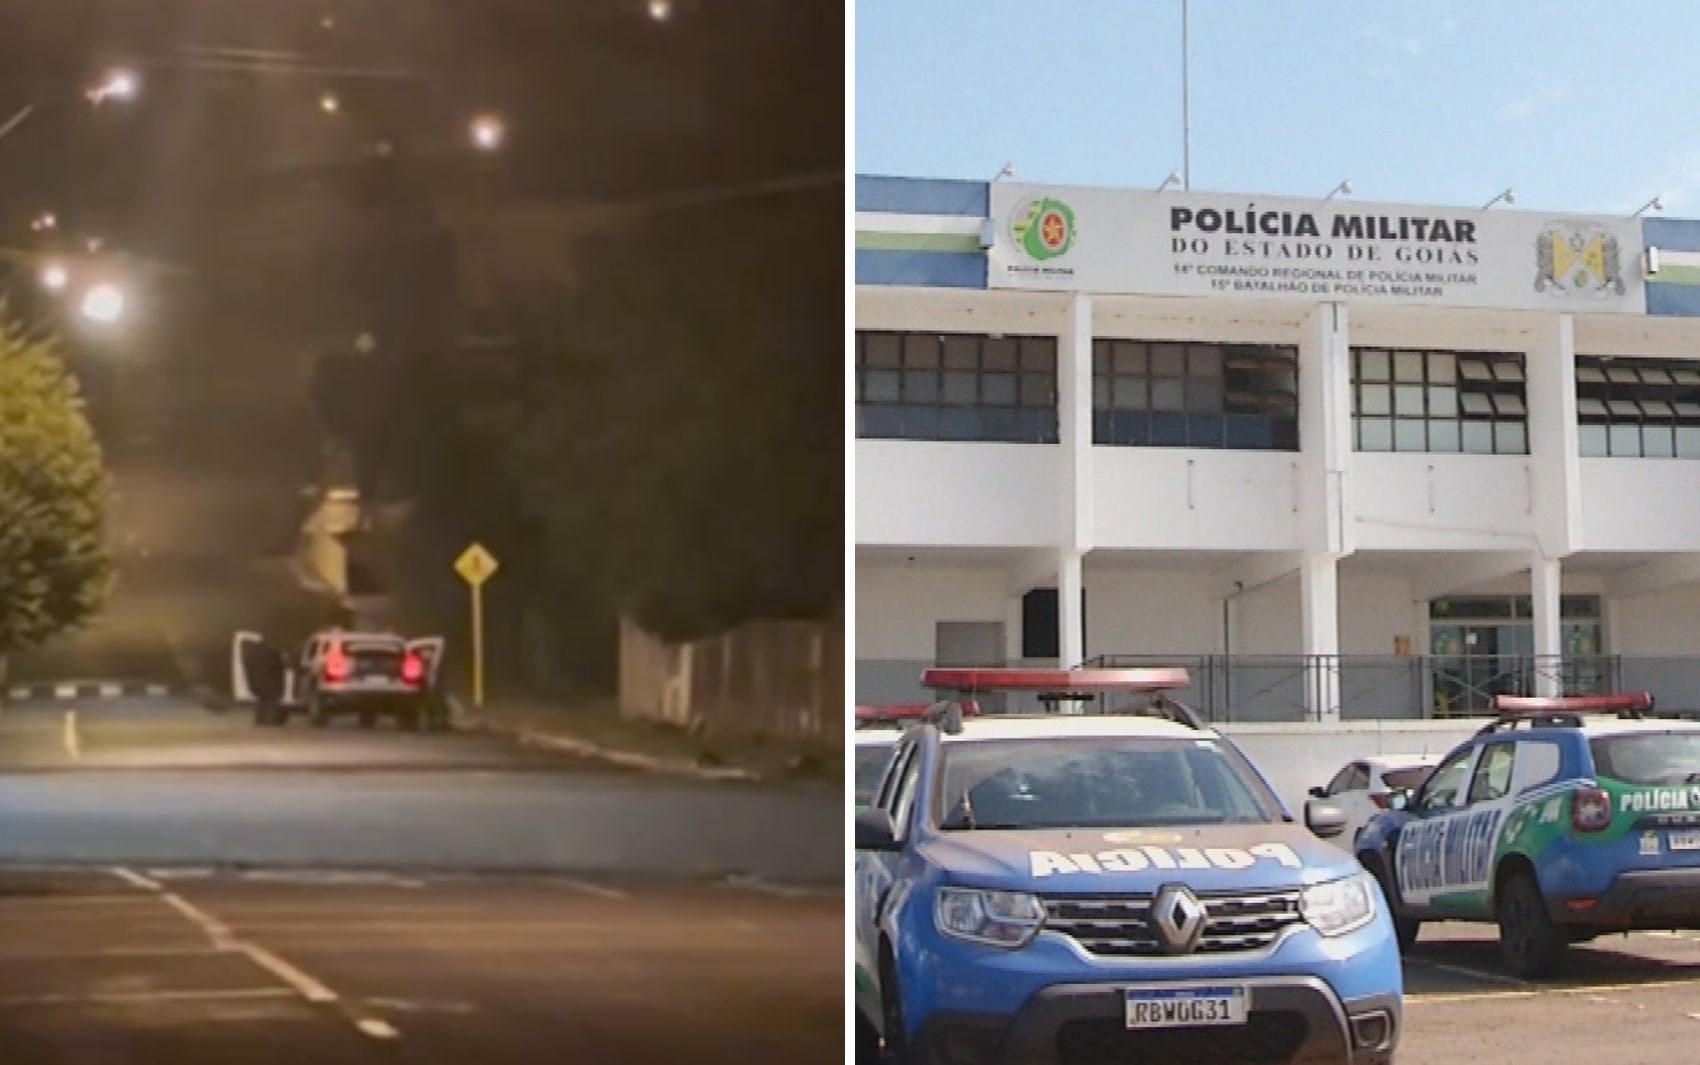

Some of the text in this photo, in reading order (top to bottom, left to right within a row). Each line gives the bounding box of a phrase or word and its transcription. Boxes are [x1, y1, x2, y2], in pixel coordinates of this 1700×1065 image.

[1170, 203, 1477, 243] POLÍCIA MILITAR
[1172, 238, 1209, 254] DO
[1225, 239, 1333, 260] ESTADO
[1348, 246, 1381, 261] DE
[1196, 265, 1269, 279] COMANDO
[1272, 268, 1342, 280] REGIONAL
[1346, 270, 1363, 280] DE
[1425, 272, 1477, 284] MILITAR
[1311, 283, 1329, 293] DE
[1390, 285, 1443, 296] MILITAR
